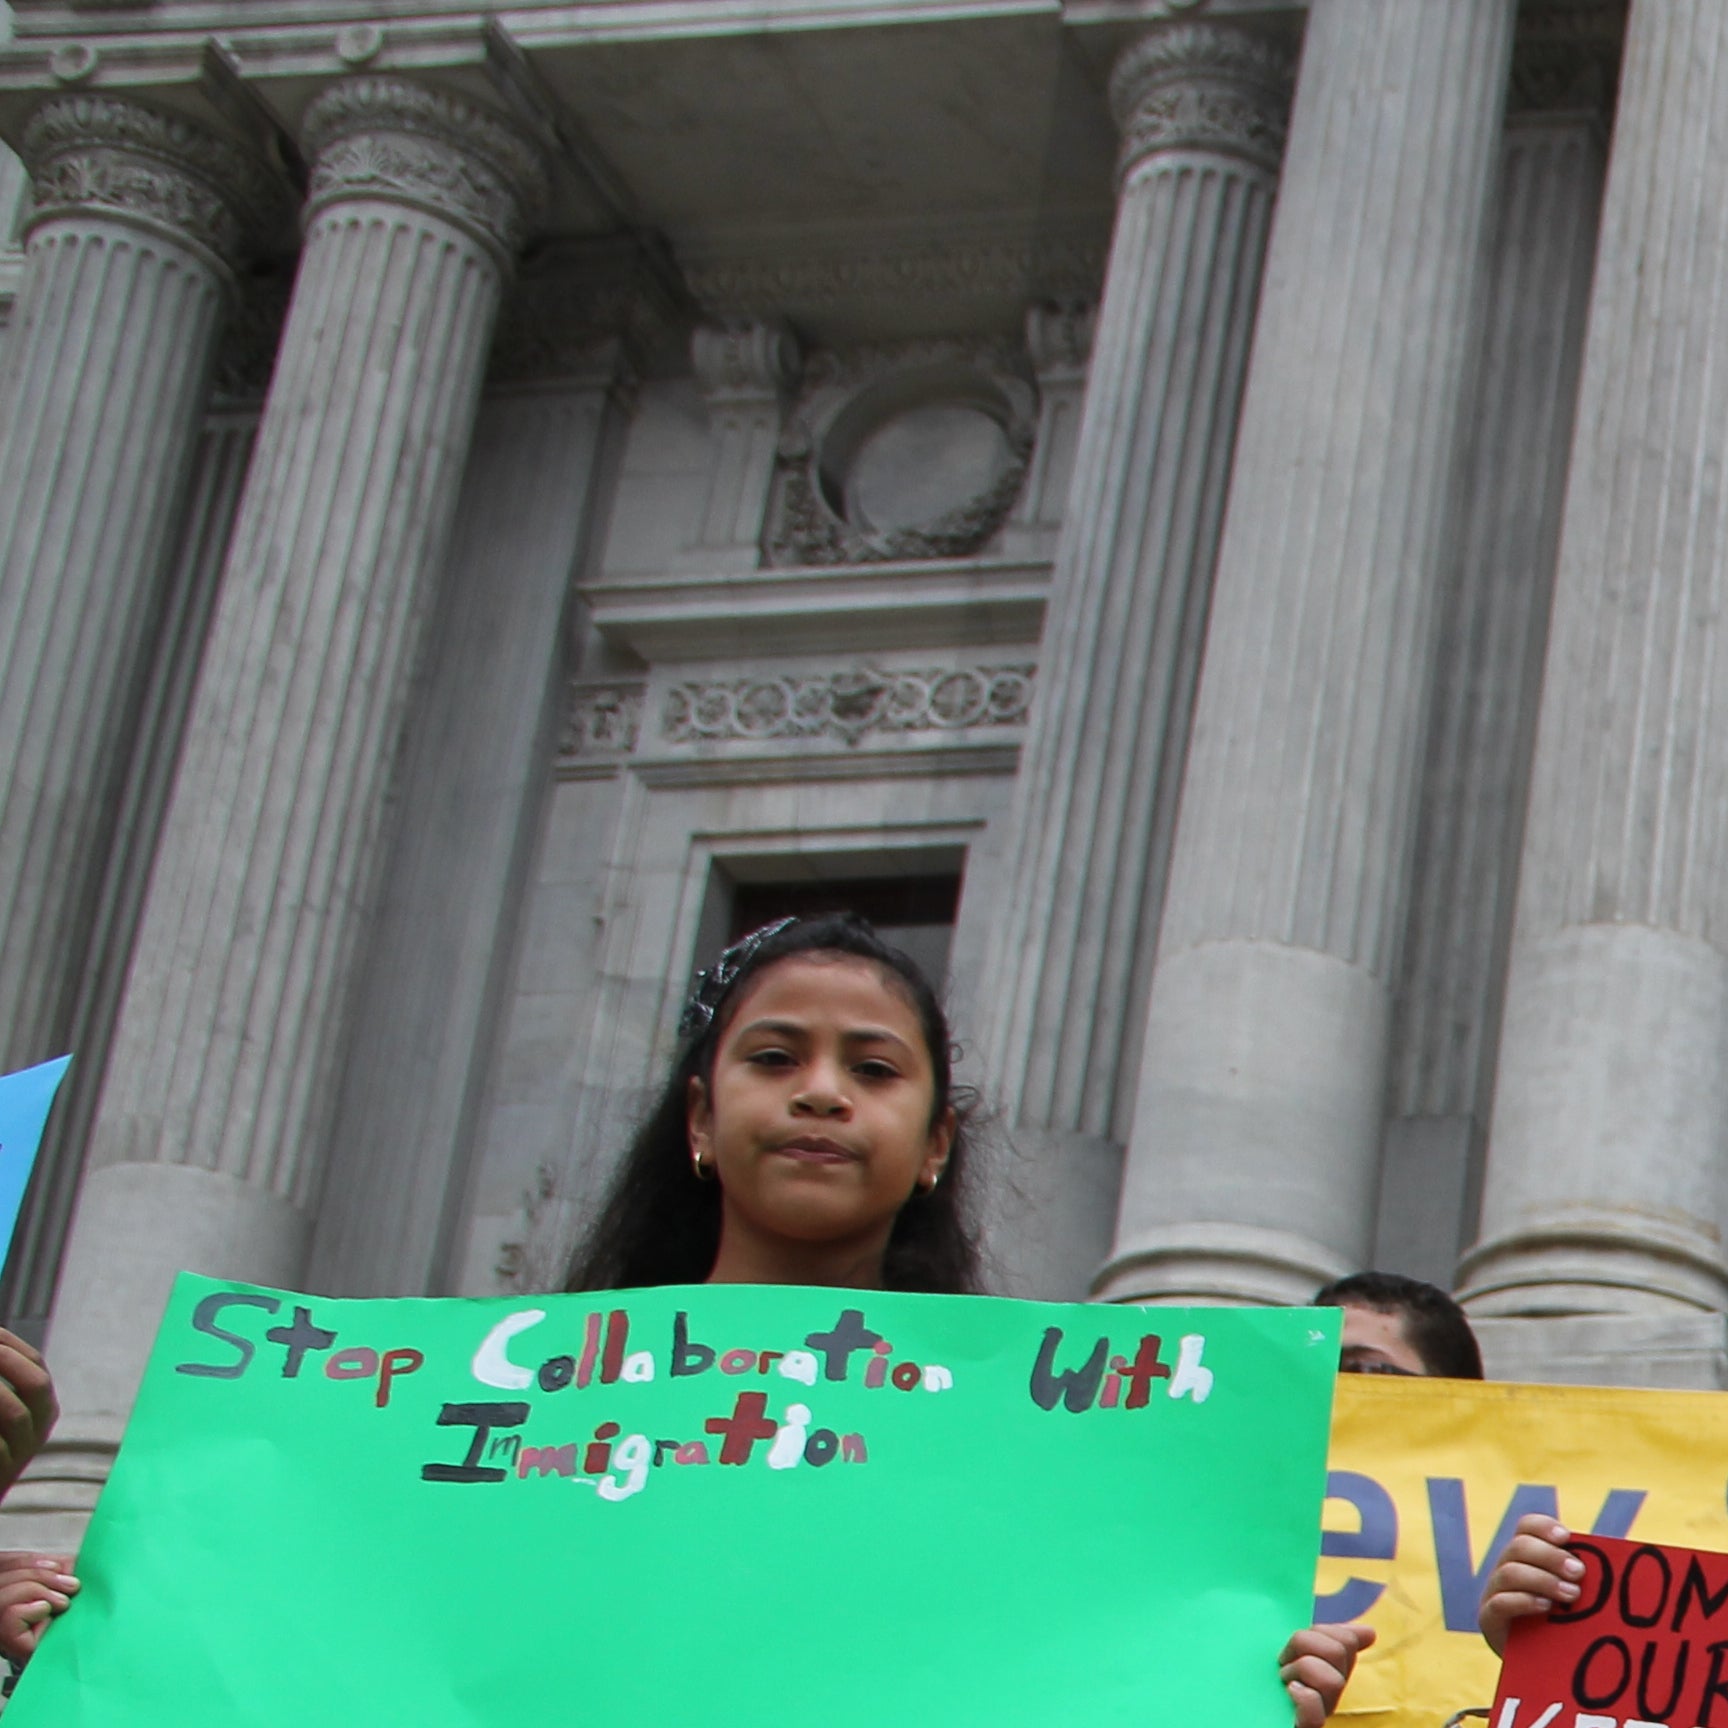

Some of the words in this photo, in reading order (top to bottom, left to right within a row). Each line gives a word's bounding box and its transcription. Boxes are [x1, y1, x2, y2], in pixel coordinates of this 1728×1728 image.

[175, 1293, 425, 1407] Stop
[471, 1309, 953, 1392] Collaboration
[1029, 1326, 1215, 1413] With
[421, 1391, 868, 1502] Immigration
[1312, 1469, 1648, 1634] ew
